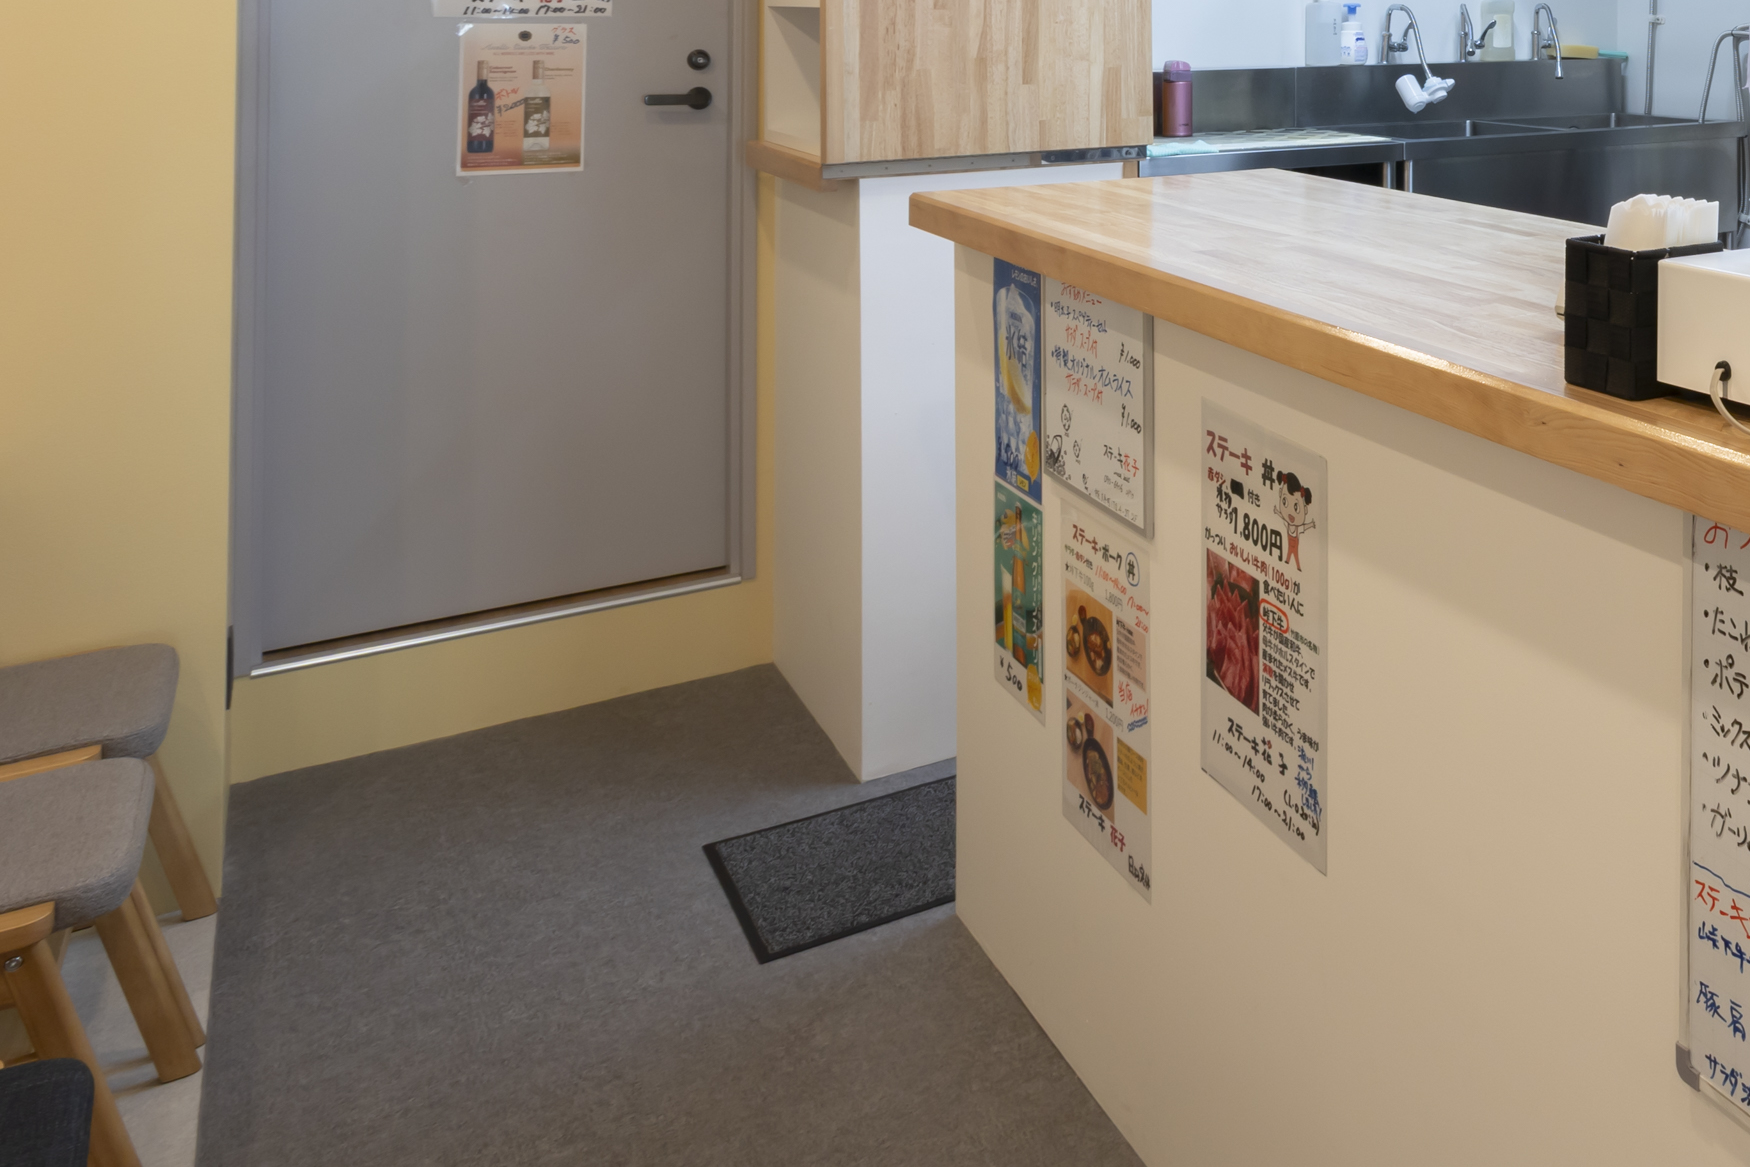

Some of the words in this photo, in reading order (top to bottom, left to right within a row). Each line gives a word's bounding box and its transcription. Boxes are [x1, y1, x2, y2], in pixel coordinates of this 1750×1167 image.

[1206, 429, 1253, 476] ステーキ
[1261, 457, 1276, 492] 丼
[1247, 487, 1261, 509] 付き
[1231, 506, 1284, 563] 1,800円
[1126, 558, 1137, 582] 丼
[1262, 578, 1305, 618] 食べたい人に
[1078, 793, 1106, 834] ステーキ
[1110, 823, 1127, 854] 花子
